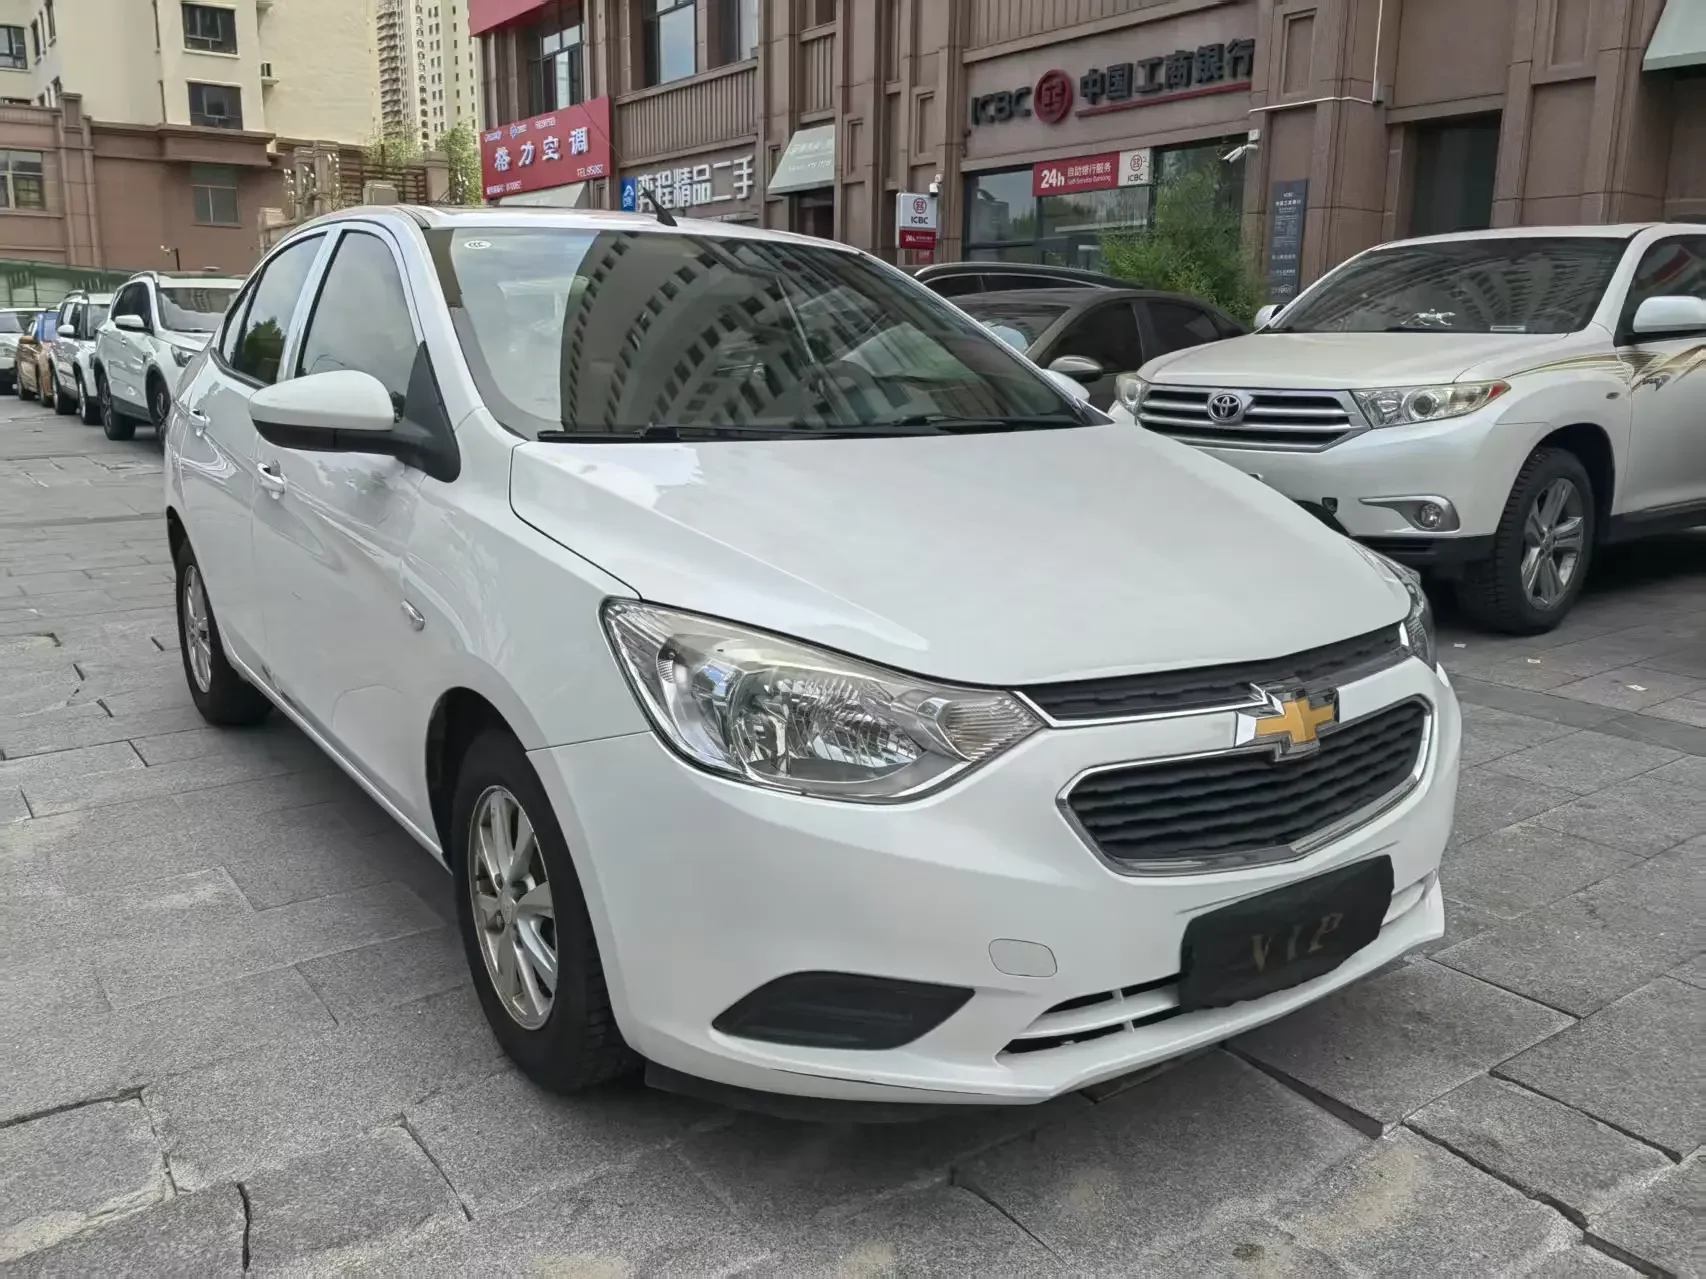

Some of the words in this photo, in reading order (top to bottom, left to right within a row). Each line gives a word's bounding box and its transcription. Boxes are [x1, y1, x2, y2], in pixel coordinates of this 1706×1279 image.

[1080, 38, 1256, 105] 中国工商银行
[971, 86, 1032, 126] ICBC
[494, 126, 589, 172] 格力空调
[1040, 168, 1065, 189] 24h
[1127, 173, 1144, 182] ICBC
[911, 216, 928, 224] ICBC
[1251, 912, 1345, 974] VIP
